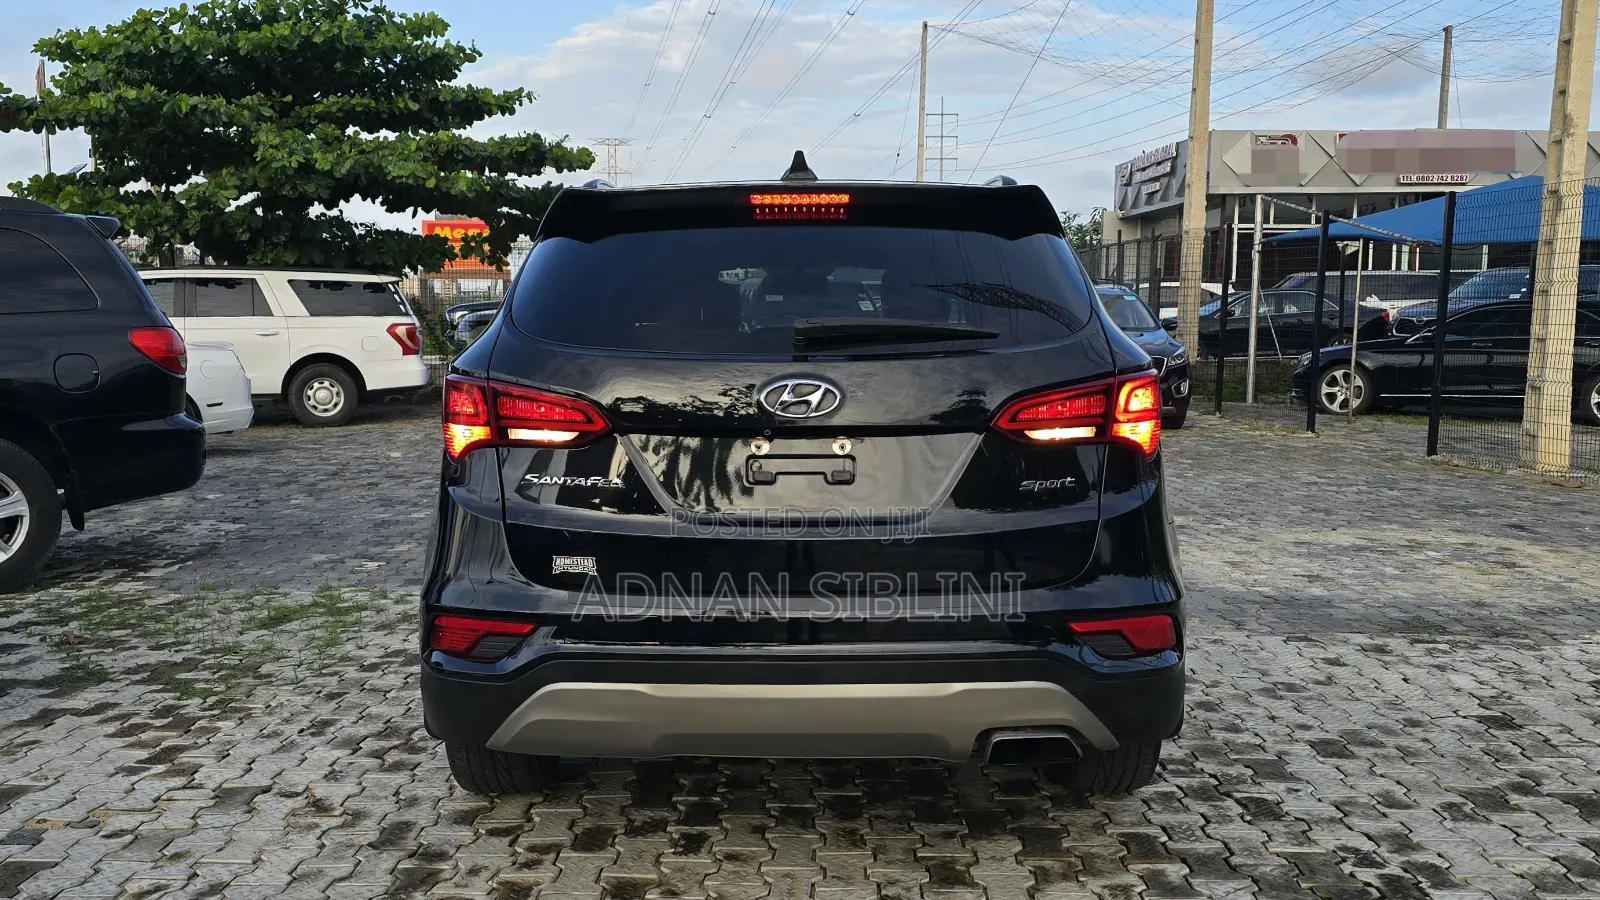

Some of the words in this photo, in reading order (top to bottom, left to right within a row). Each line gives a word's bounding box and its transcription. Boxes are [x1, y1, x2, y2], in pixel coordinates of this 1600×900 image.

[1416, 174, 1434, 182] 0802
[1436, 174, 1449, 182] 742
[1450, 174, 1469, 182] 8287
[555, 557, 593, 567] HOMESTEAD
